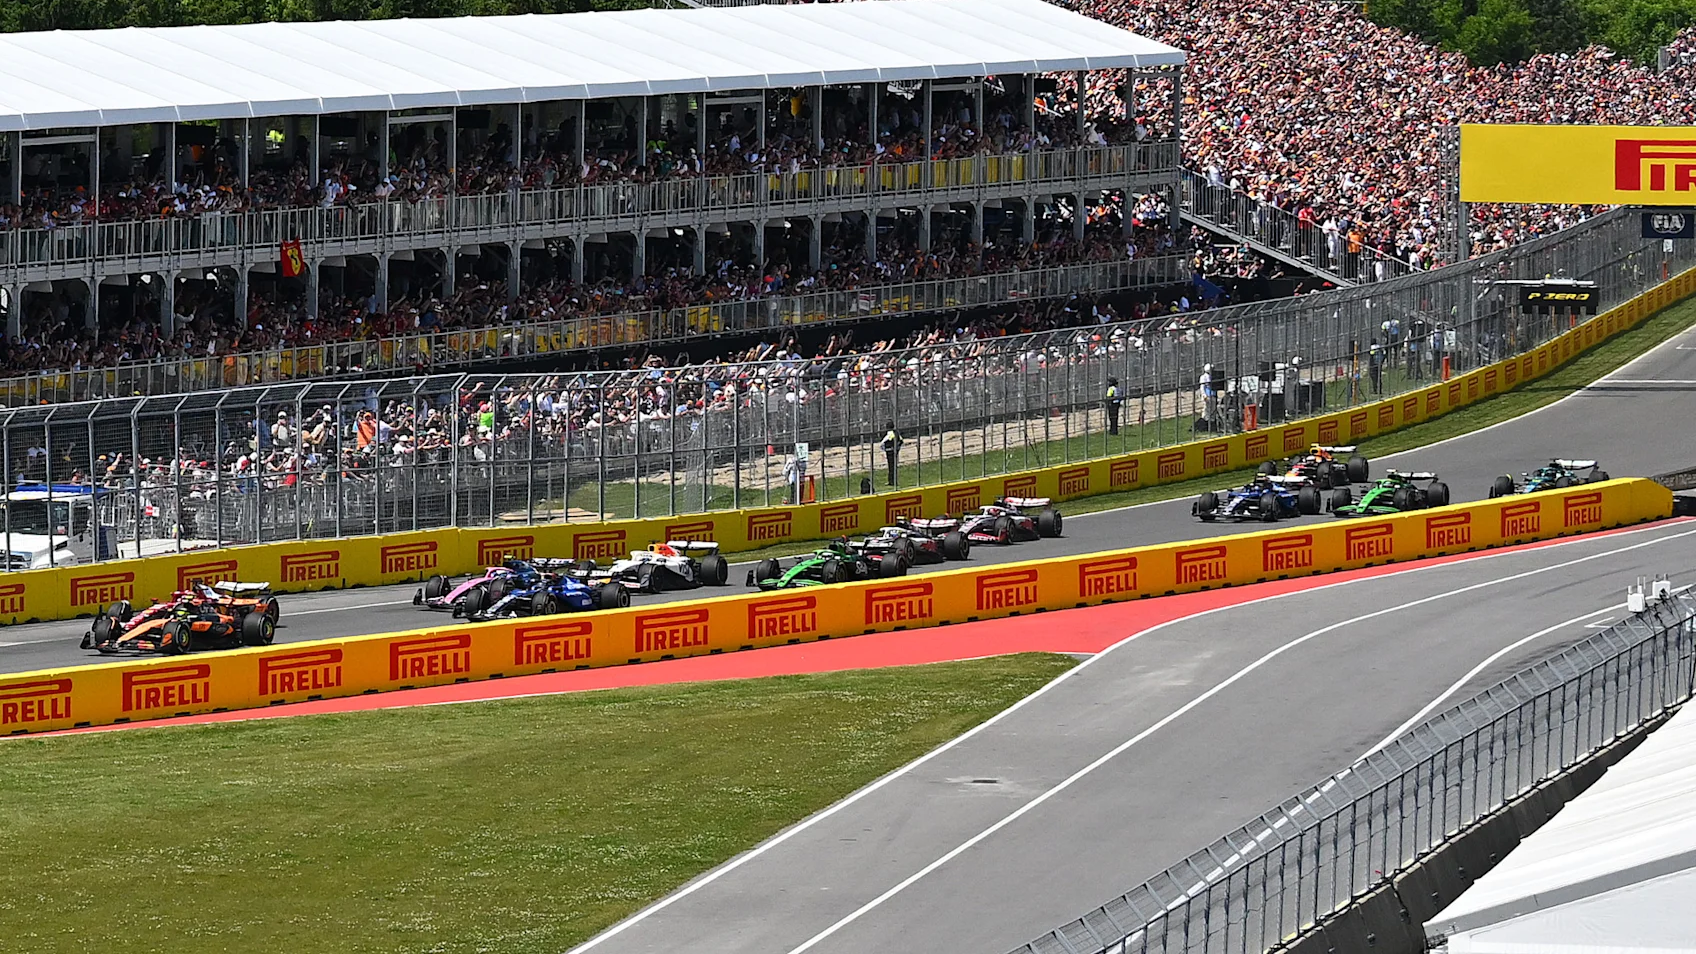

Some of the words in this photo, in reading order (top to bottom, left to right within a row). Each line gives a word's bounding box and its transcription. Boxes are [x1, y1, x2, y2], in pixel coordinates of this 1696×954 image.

[1528, 292, 1542, 300] P
[1543, 292, 1591, 301] ZERO
[1245, 435, 1269, 461] PIRELLI
[1283, 427, 1305, 452] PIRELLI
[1318, 420, 1339, 444] PIRELLI
[1110, 459, 1139, 486] PIRELLI
[1157, 452, 1185, 479] PIRELLI
[1204, 443, 1228, 470] PIRELLI
[1059, 467, 1090, 496] PIRELLI
[946, 486, 981, 514] PIRELLI
[1564, 492, 1603, 527] PIRELLI
[748, 512, 793, 541] PIRELLI
[821, 504, 859, 533] PIRELLI
[1426, 512, 1471, 549] PIRELLI
[1501, 501, 1541, 538] PIRELLI
[381, 541, 438, 574] PIRELLI
[573, 530, 627, 559] PIRELLI
[1262, 533, 1313, 572] PIRELLI
[1346, 523, 1394, 561] PIRELLI
[281, 550, 340, 582] PIRELLI
[1079, 557, 1138, 598] PIRELLI
[1176, 545, 1227, 585] PIRELLI
[70, 572, 135, 606] PIRELLI
[865, 582, 933, 625] PIRELLI
[976, 569, 1039, 610] PIRELLI
[635, 608, 710, 653] PIRELLI
[748, 595, 817, 639] PIRELLI
[390, 634, 472, 681] PIRELLI
[514, 621, 593, 665] PIRELLI
[122, 664, 211, 712] PIRELLI
[258, 648, 343, 696] PIRELLI
